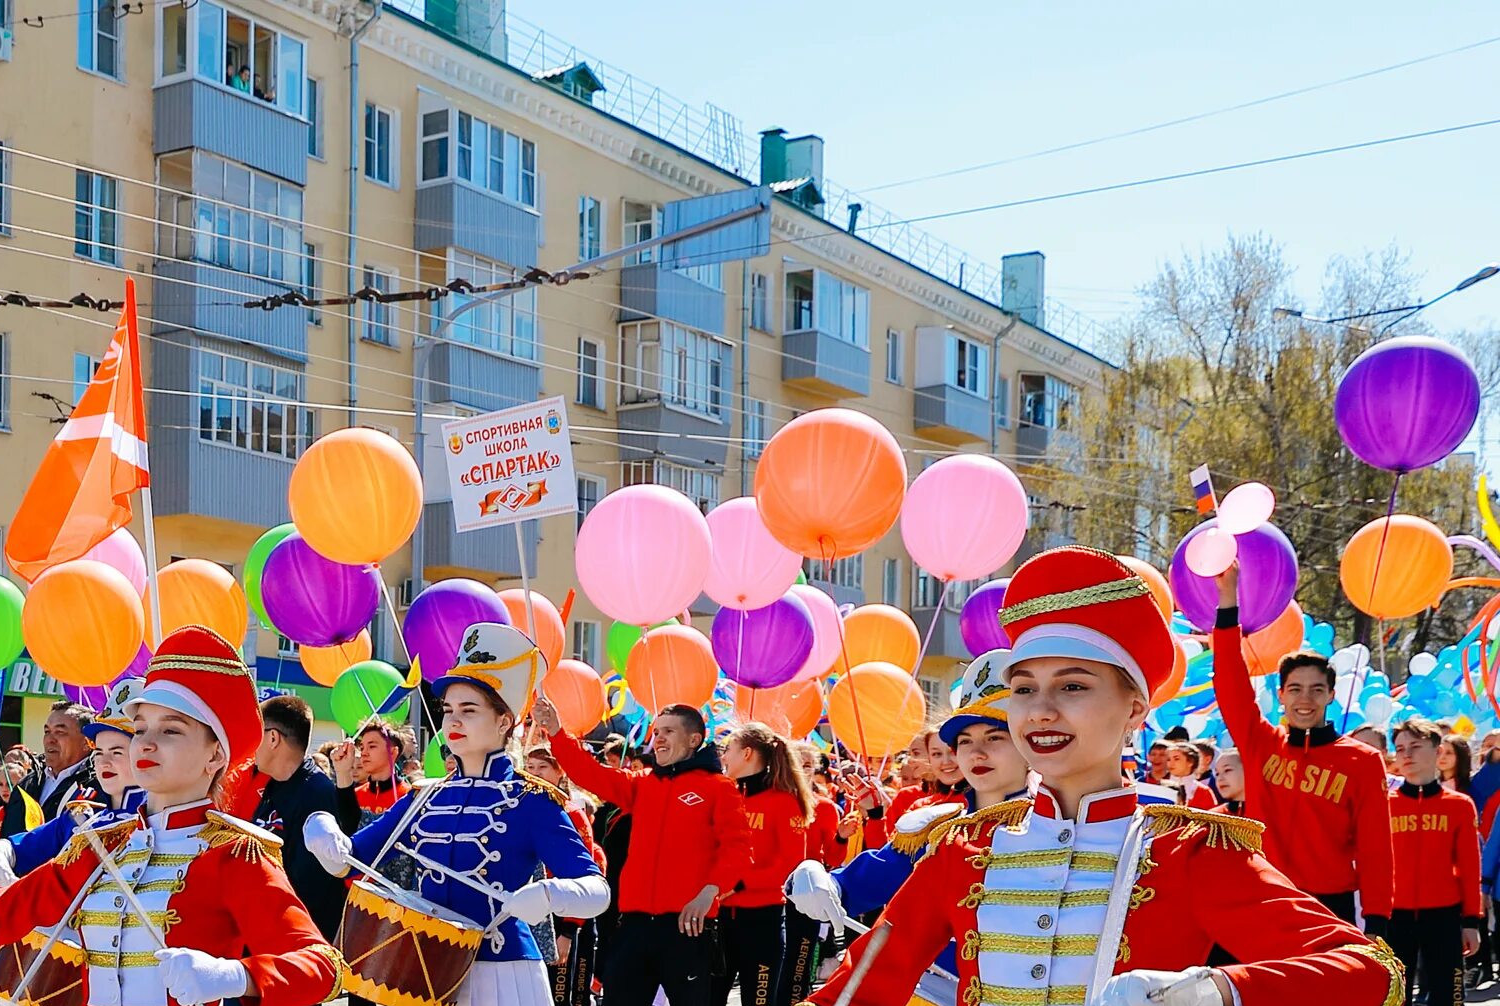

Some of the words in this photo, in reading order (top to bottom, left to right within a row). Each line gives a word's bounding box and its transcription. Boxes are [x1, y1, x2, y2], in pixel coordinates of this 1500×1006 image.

[466, 416, 543, 445] СПОРТИВНАЯ
[485, 437, 528, 457] ШКОЛА
[460, 450, 561, 487] «СПАРТАК»
[793, 937, 810, 982] AEROBIC
[554, 962, 568, 1003] EROBIC
